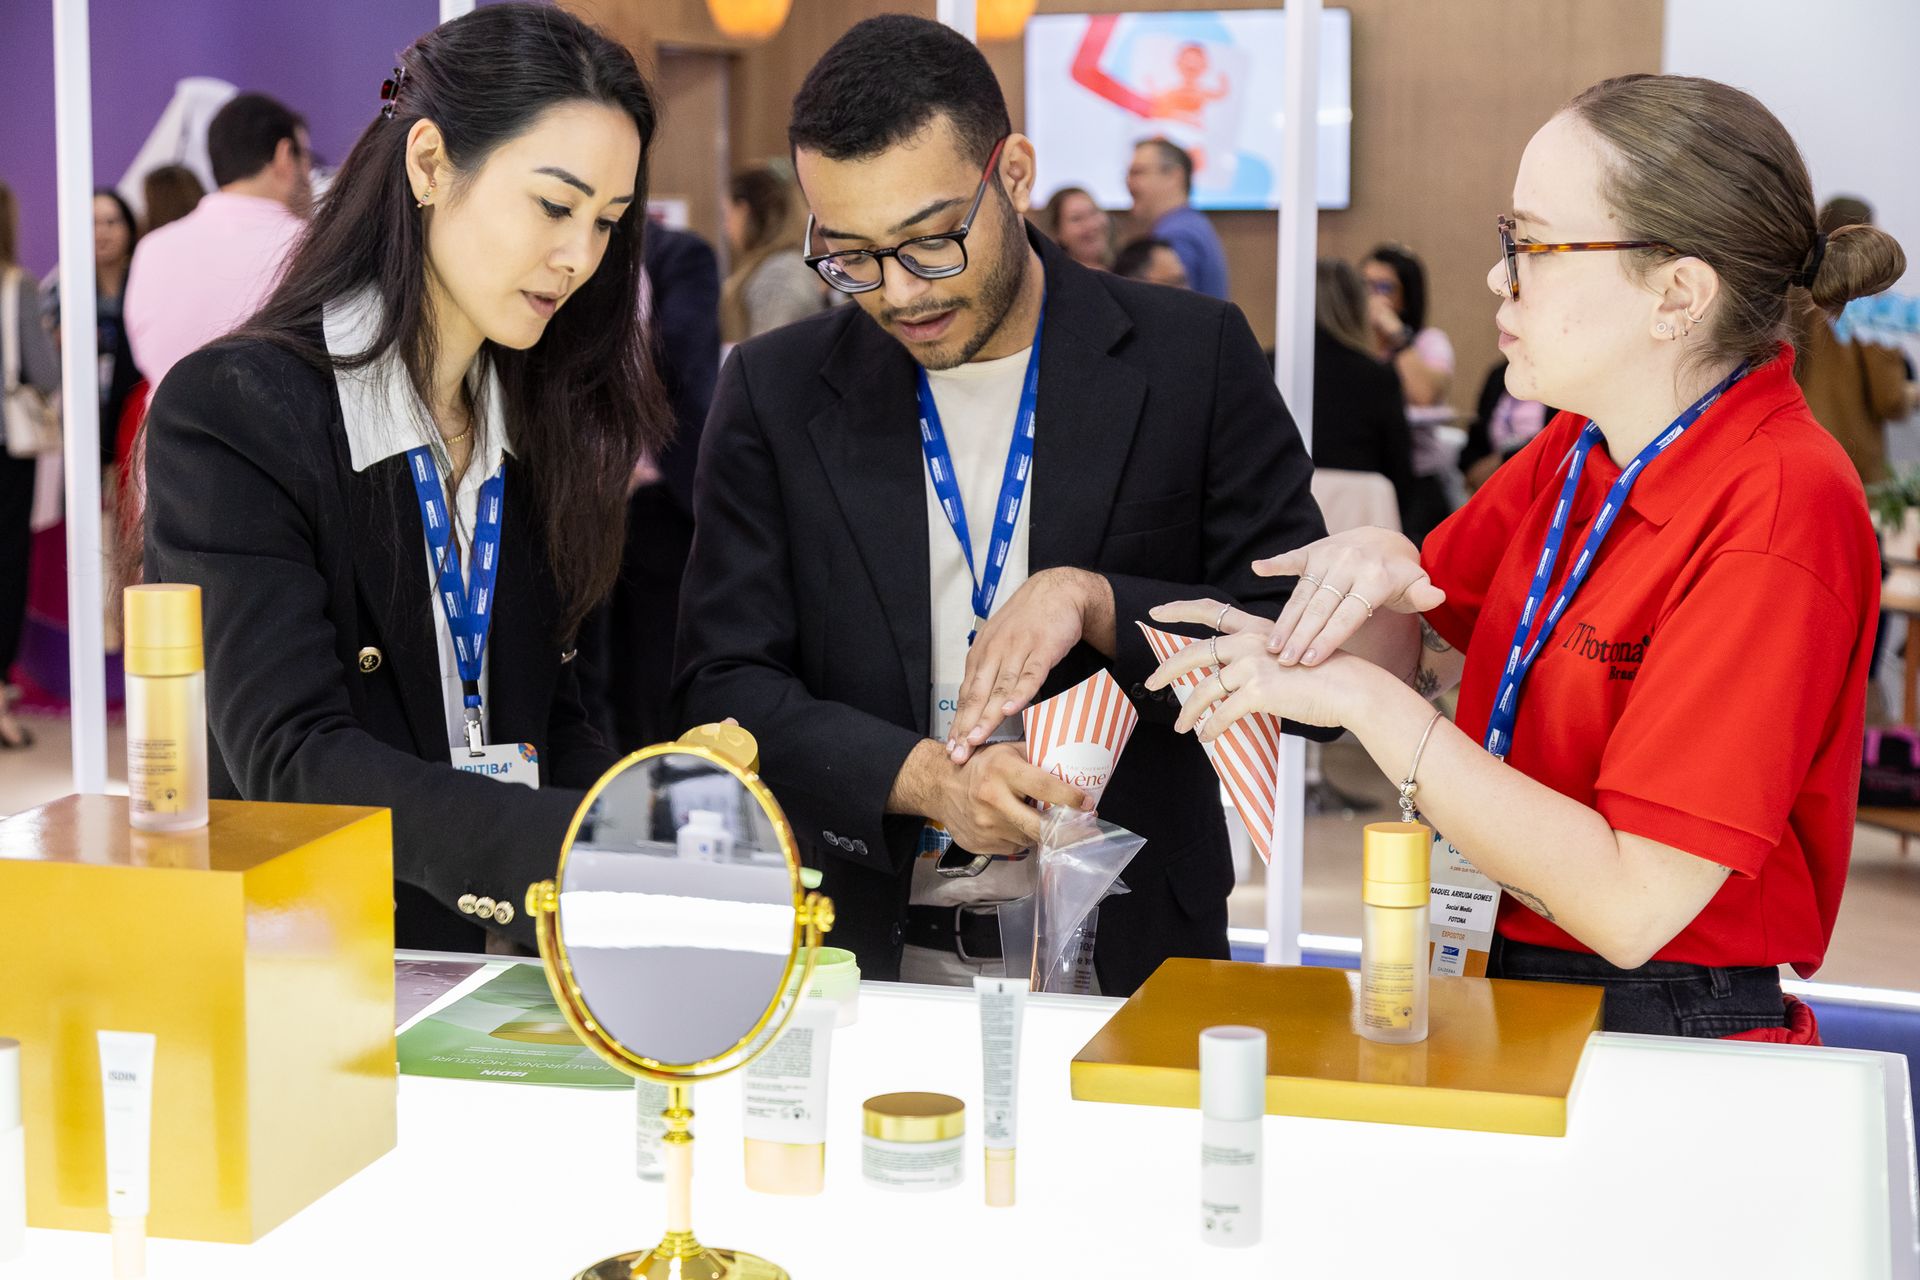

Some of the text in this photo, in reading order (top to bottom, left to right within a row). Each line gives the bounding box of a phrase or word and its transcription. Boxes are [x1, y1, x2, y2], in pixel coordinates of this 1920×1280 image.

[1050, 762, 1107, 787] Avène
[1430, 887, 1493, 902] RAQUEL ARRUDA GOMES
[1445, 903, 1459, 911] Social
[1448, 916, 1467, 924] FOTONA
[429, 1055, 508, 1066] MOISTURE
[108, 1070, 137, 1082] ISDIN
[479, 1069, 529, 1078] ISDIN
